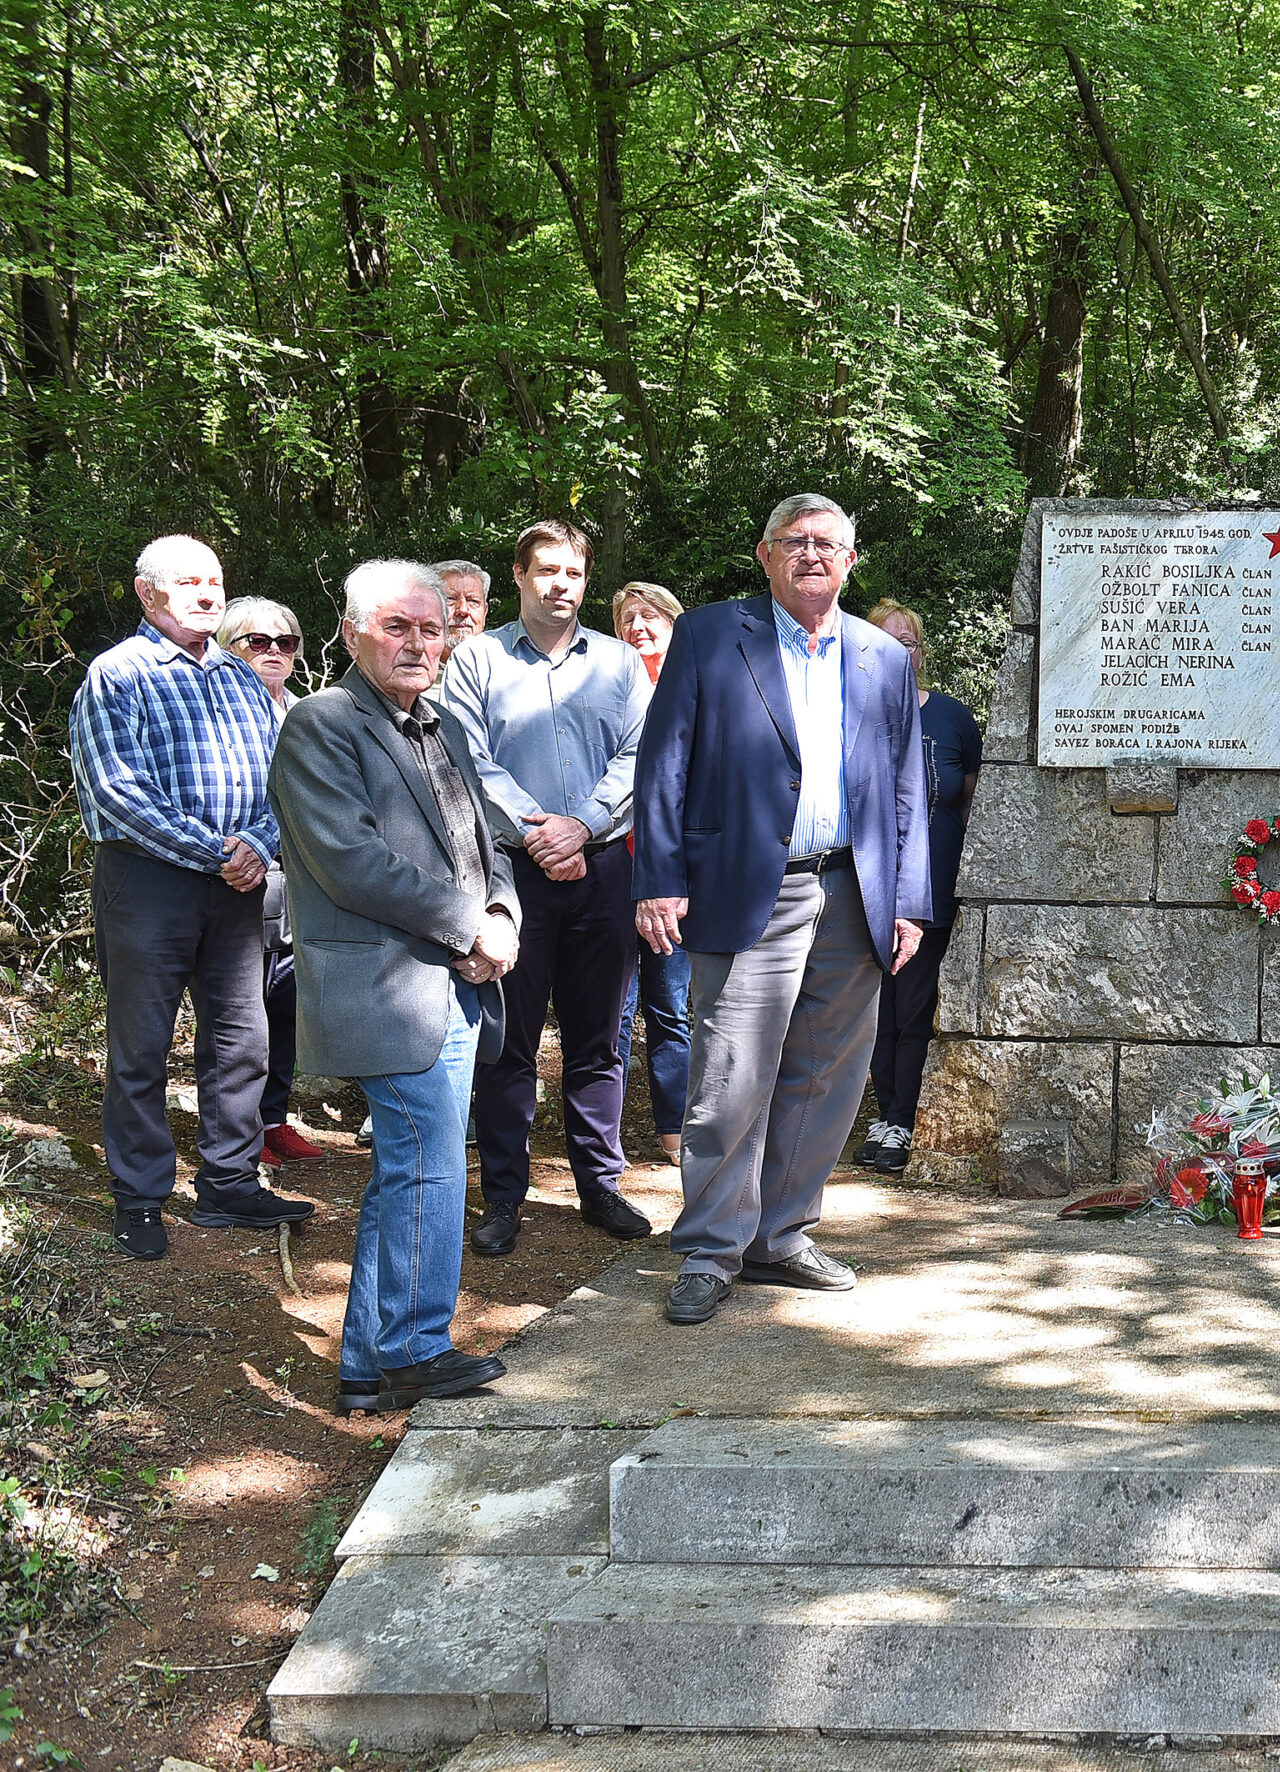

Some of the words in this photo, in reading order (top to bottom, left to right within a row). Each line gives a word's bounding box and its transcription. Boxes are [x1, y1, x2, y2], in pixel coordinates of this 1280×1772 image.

[1058, 529, 1093, 538] OVDJE
[1098, 527, 1137, 538] PADOŠE
[1142, 529, 1149, 538] U
[1155, 529, 1194, 538] APRILU
[1199, 529, 1225, 538] 1945.
[1229, 530, 1252, 539] GOD.
[1058, 543, 1094, 554] ŽRTVE
[1100, 543, 1168, 555] FAŠISTIČKOG
[1174, 545, 1218, 555] TERORA
[1101, 562, 1151, 578] RAKIĆ
[1162, 565, 1235, 578] BOSILJKA
[1242, 568, 1272, 579] ČLAN
[1101, 580, 1160, 596] OŽBOLT
[1172, 584, 1231, 596] FANICA
[1242, 586, 1272, 598] ČLAN
[1101, 598, 1144, 614] SUŠIĆ
[1157, 601, 1200, 614] VERA
[1242, 604, 1272, 615] ČLAN
[1101, 619, 1134, 632] BAN
[1146, 619, 1210, 632] MARIJA
[1242, 623, 1271, 633] ČLAN
[1100, 635, 1160, 650] MARAČ
[1172, 638, 1215, 650] MIRA
[1241, 640, 1271, 651] ČLAN
[1101, 655, 1168, 668] JELACICH
[1178, 656, 1235, 668] NERINA
[1100, 670, 1148, 686] ROŽIĆ
[1160, 674, 1195, 686] EMA
[1055, 709, 1115, 719] HEROJSKIM
[1123, 709, 1205, 719] DRUGARICAMA
[1055, 724, 1083, 733] OVAJ
[1091, 724, 1134, 733] SPOMEN
[1055, 739, 1089, 748] SAVEZ
[1095, 739, 1140, 748] BORACA
[1156, 739, 1202, 748] RAJONA
[1208, 740, 1247, 749] RIJEKA
